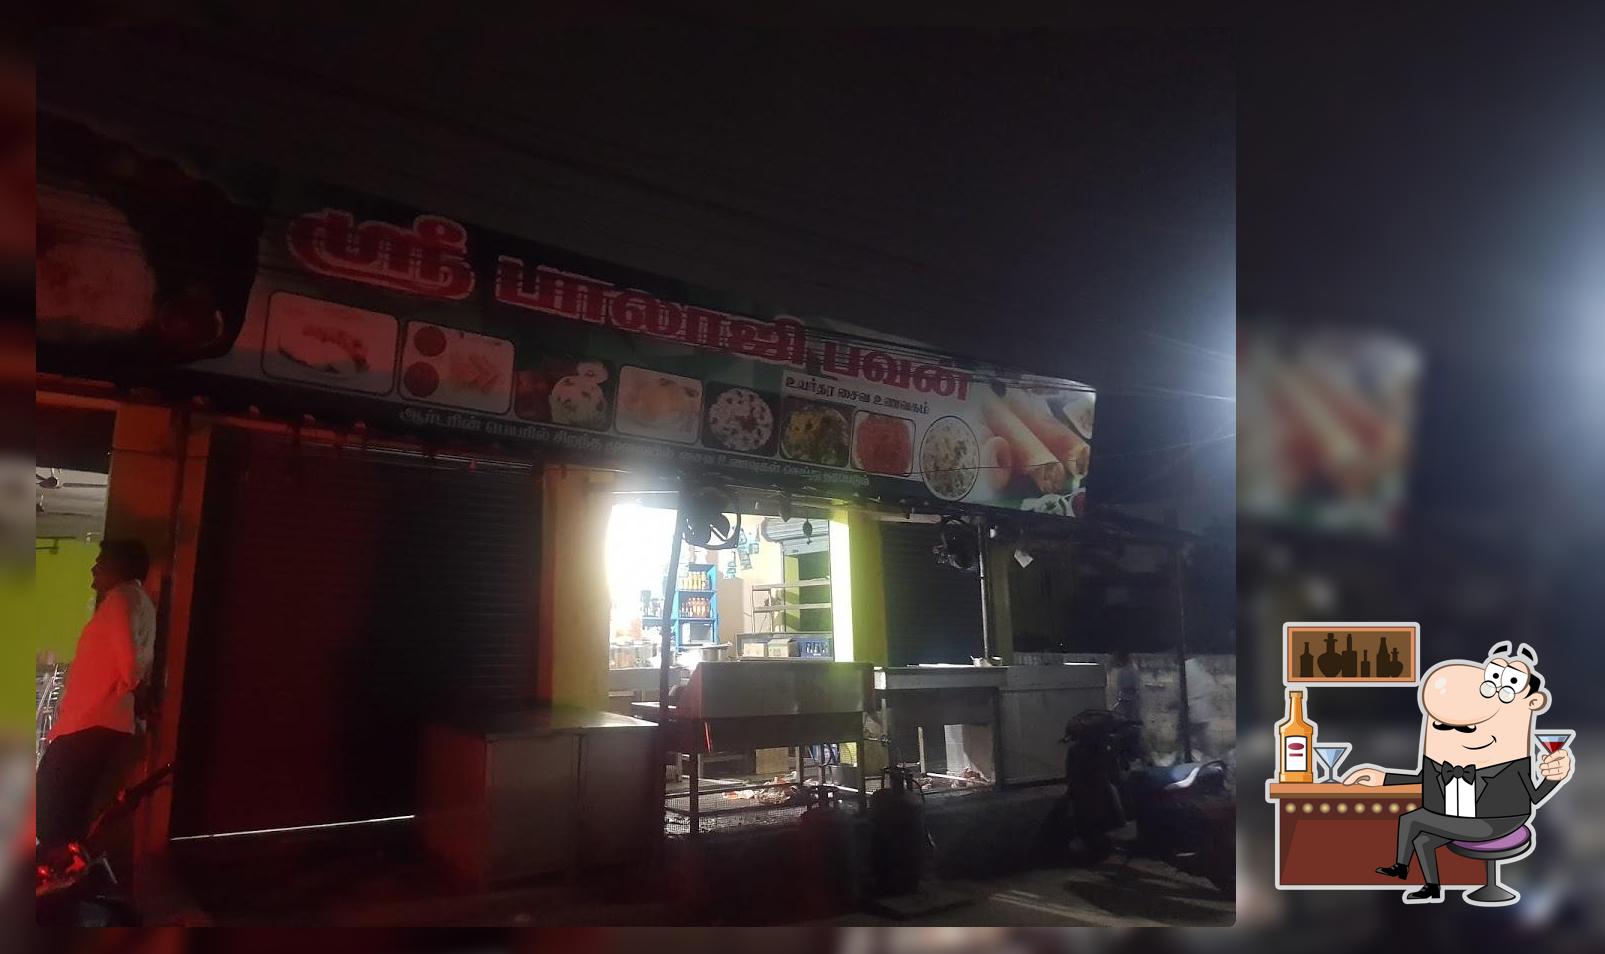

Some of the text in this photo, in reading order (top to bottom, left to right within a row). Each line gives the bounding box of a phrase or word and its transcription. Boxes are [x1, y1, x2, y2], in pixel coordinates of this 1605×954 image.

[495, 254, 807, 369] பாலாஜி
[820, 340, 971, 401] பவன்
[786, 376, 930, 415] உயர்தர சைவ உணவகம்
